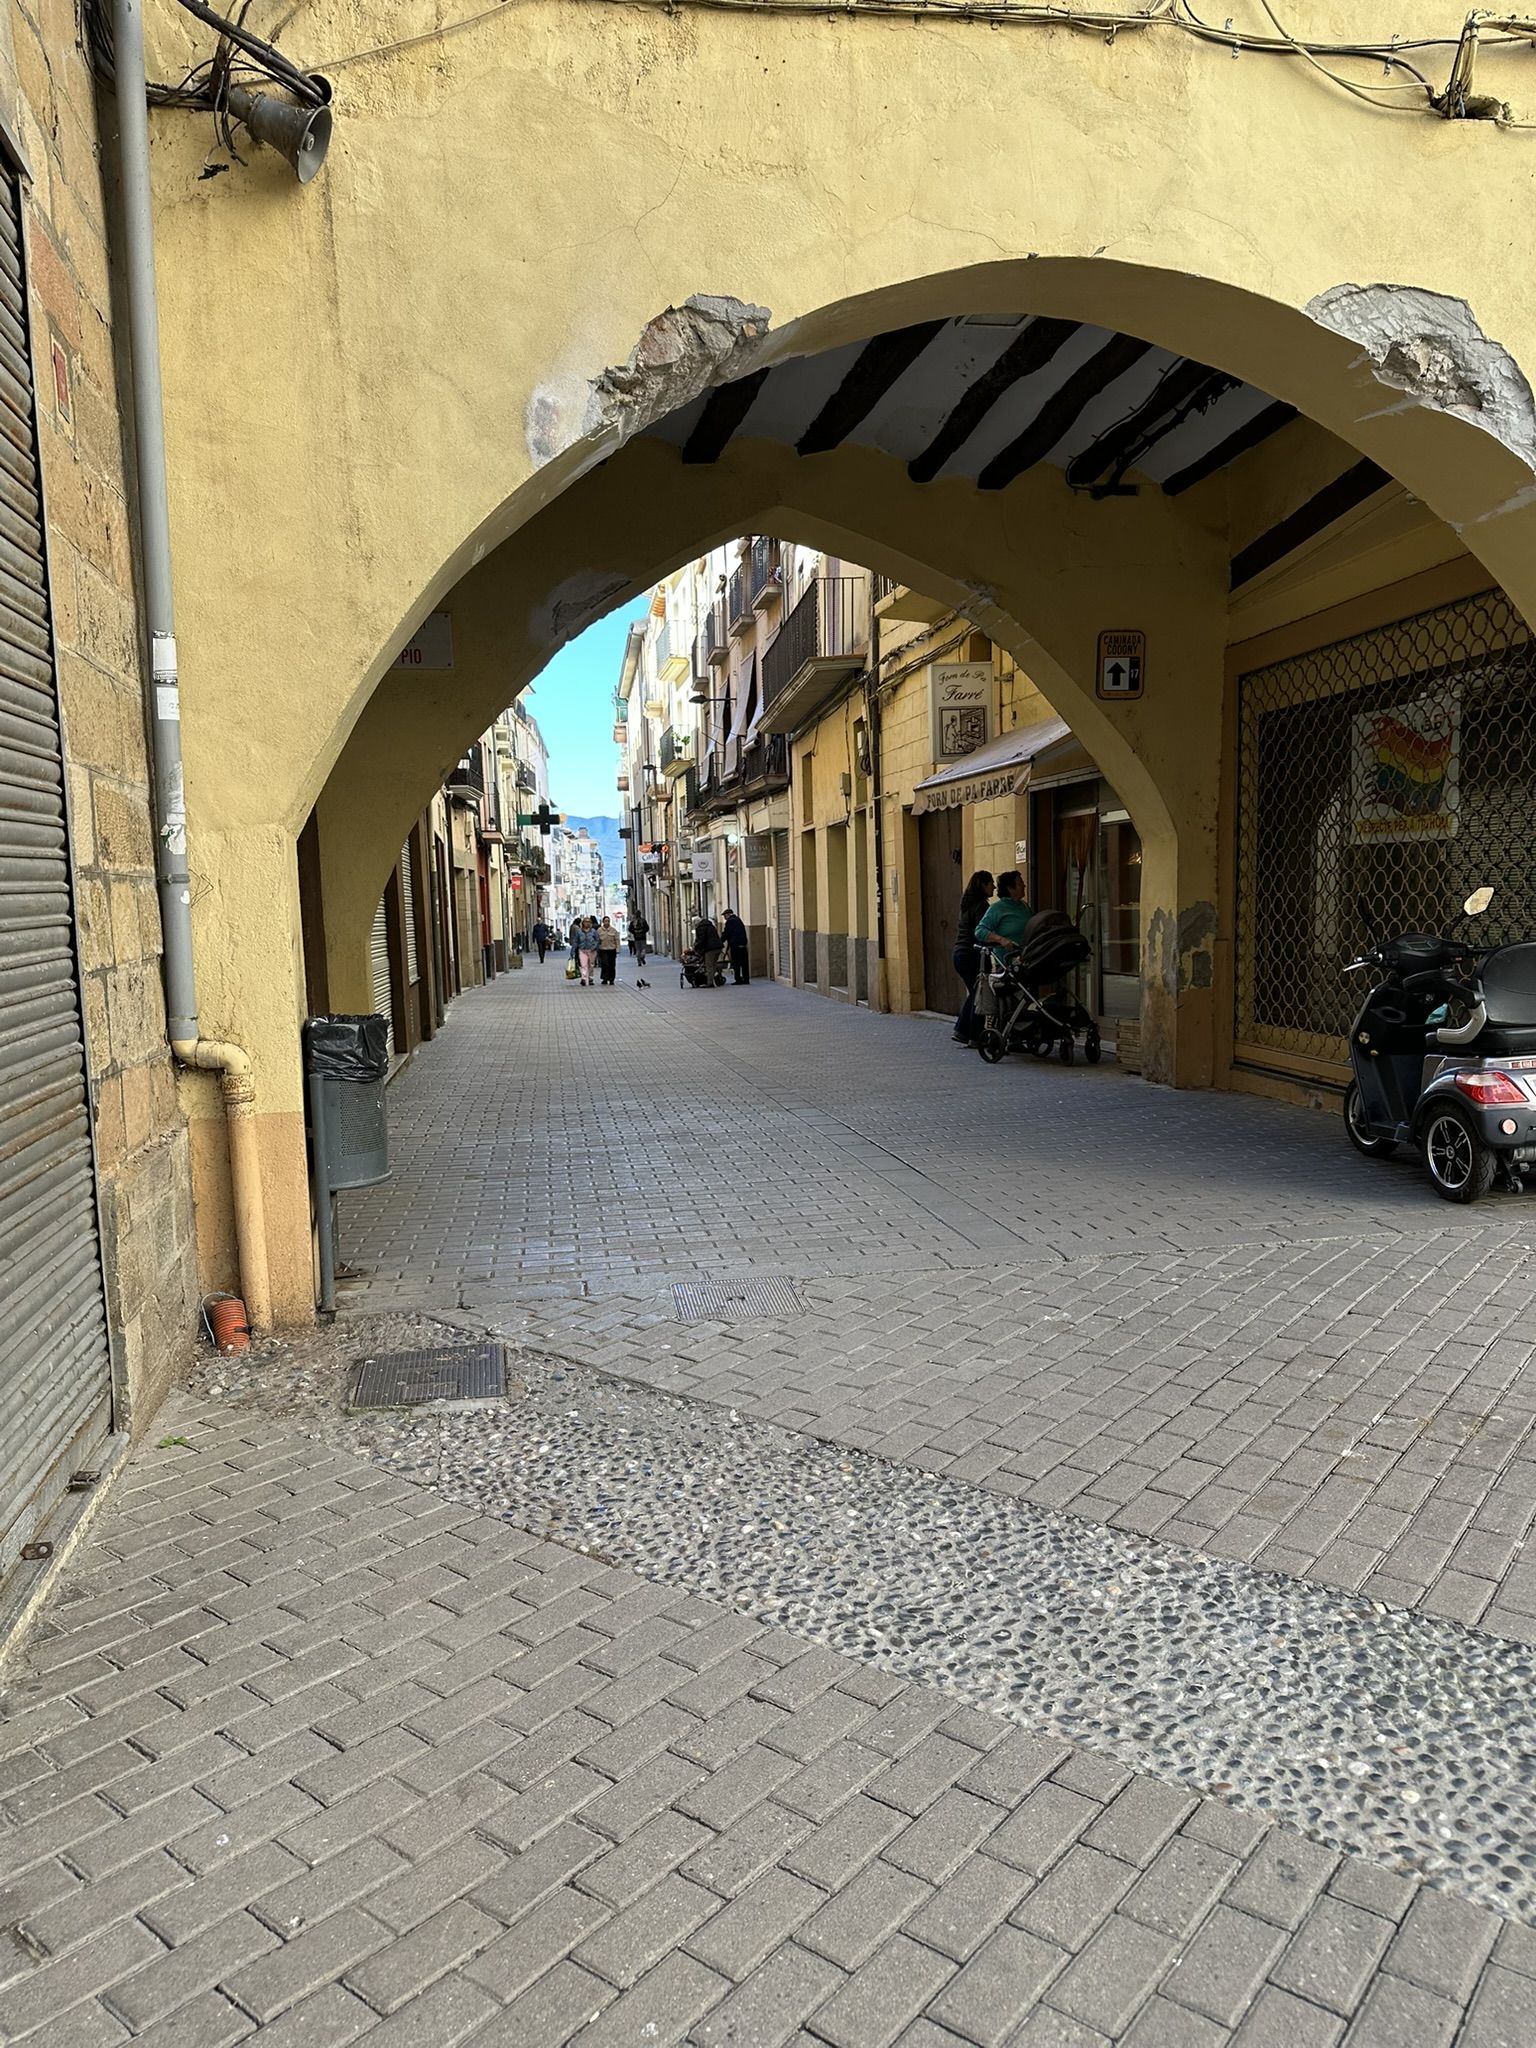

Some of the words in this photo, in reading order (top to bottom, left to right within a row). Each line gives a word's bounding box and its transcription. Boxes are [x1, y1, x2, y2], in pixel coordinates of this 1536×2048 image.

[959, 669, 971, 679] de
[971, 670, 987, 682] Pa
[1130, 669, 1139, 679] 17
[943, 684, 983, 701] Farré
[927, 791, 948, 808] FORN
[950, 787, 963, 804] DE
[965, 784, 978, 801] PA
